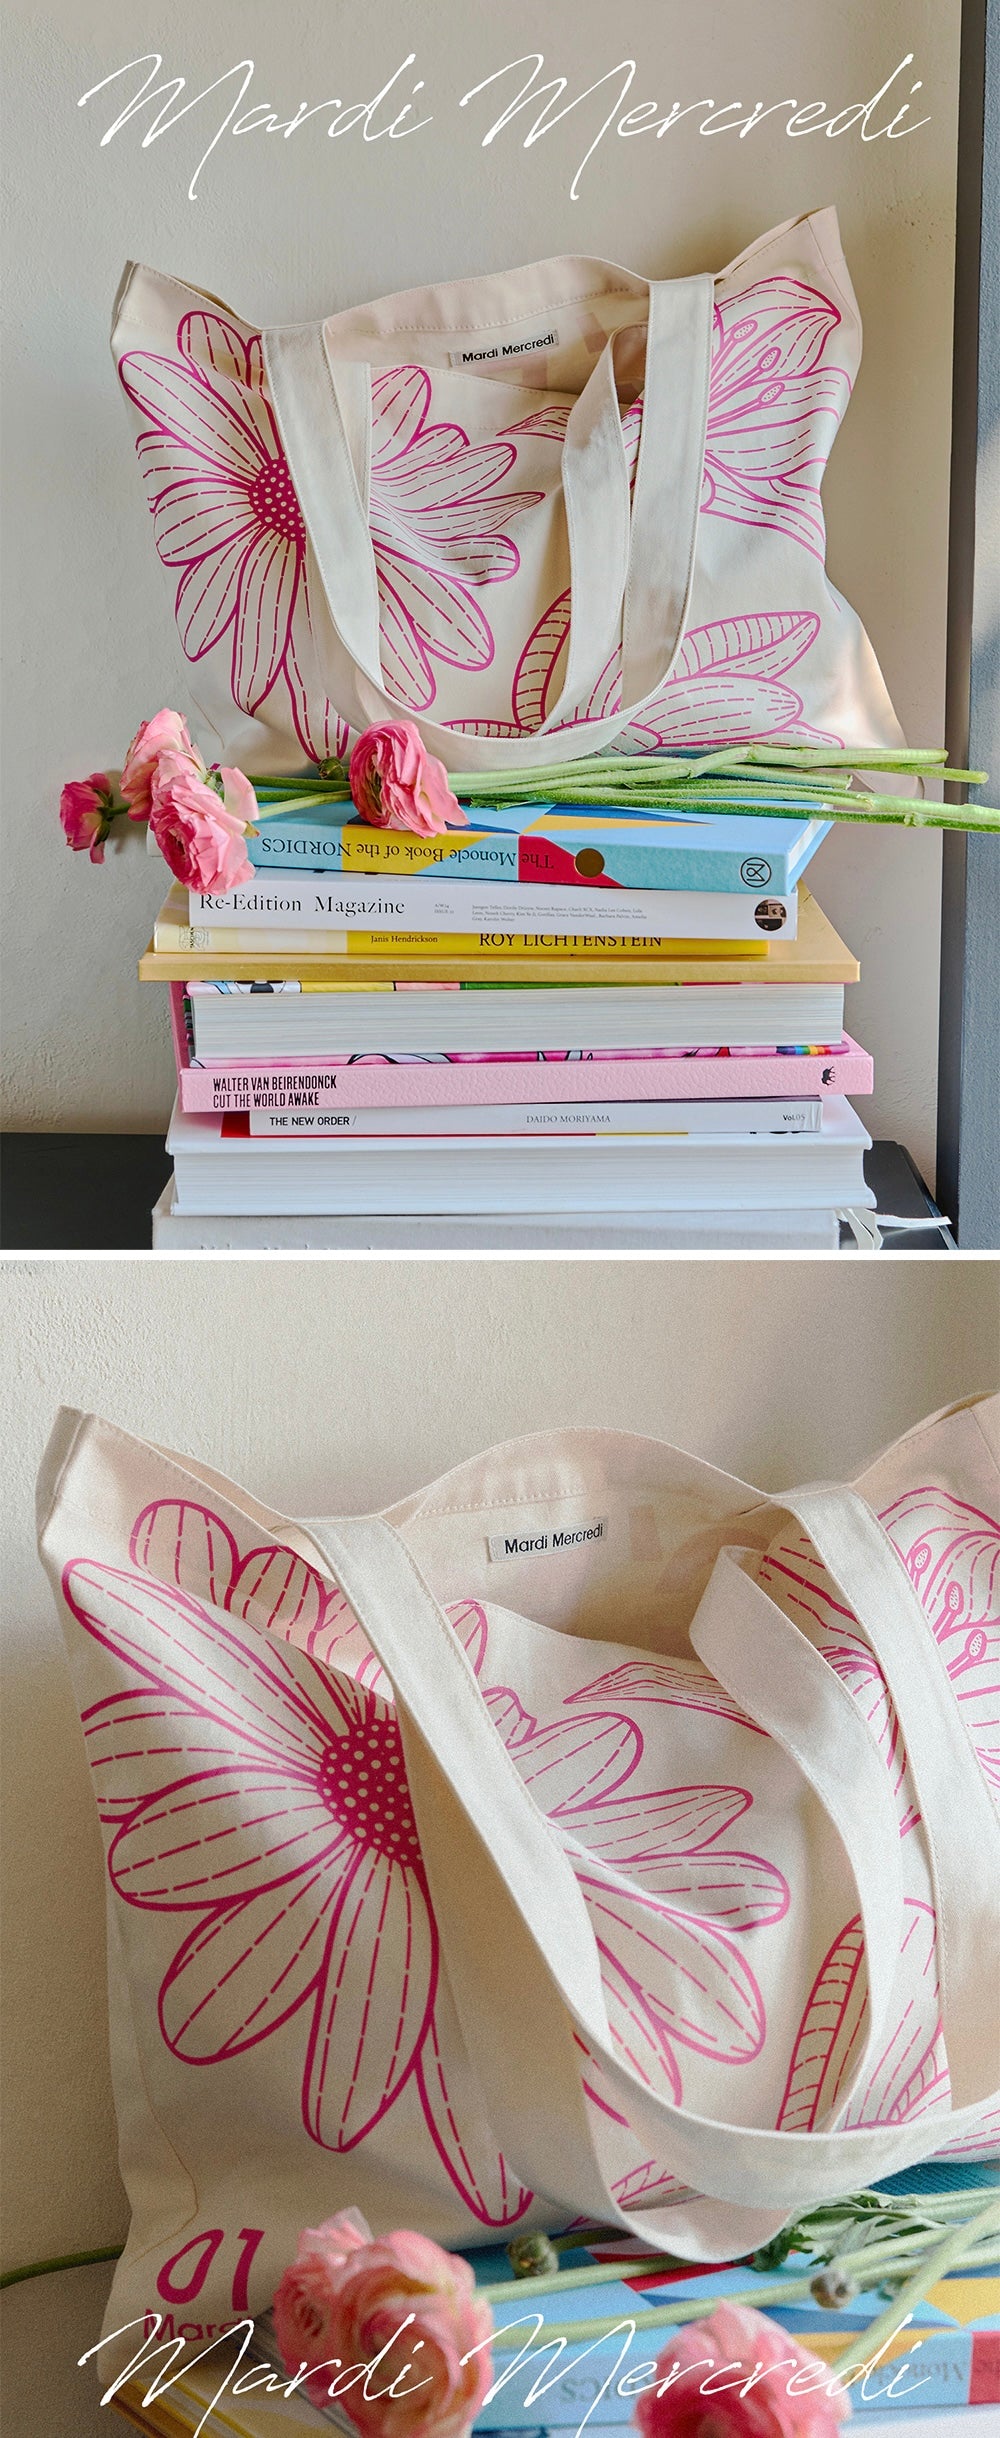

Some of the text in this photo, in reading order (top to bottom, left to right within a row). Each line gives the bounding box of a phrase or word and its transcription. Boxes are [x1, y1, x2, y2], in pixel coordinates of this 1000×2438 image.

[462, 333, 555, 362] Mardi Mercredi
[262, 838, 554, 869] The Monocle Book of the NORDICS
[199, 893, 405, 917] Re-Edition Magazine
[370, 935, 438, 944] Janis Hendrickson
[480, 933, 515, 946] ROY
[213, 1075, 337, 1092] WALTER VAN BEIRENDONCK
[213, 1092, 319, 1108] CUT THE WORLD AWAKE
[270, 1116, 288, 1126] THE
[291, 1116, 314, 1126] NEW
[317, 1115, 350, 1126] ORDER
[526, 1115, 611, 1123] DAIDO MORIYAMA
[504, 1523, 604, 1554] Mardi Mercredi
[156, 2228, 265, 2312] 01
